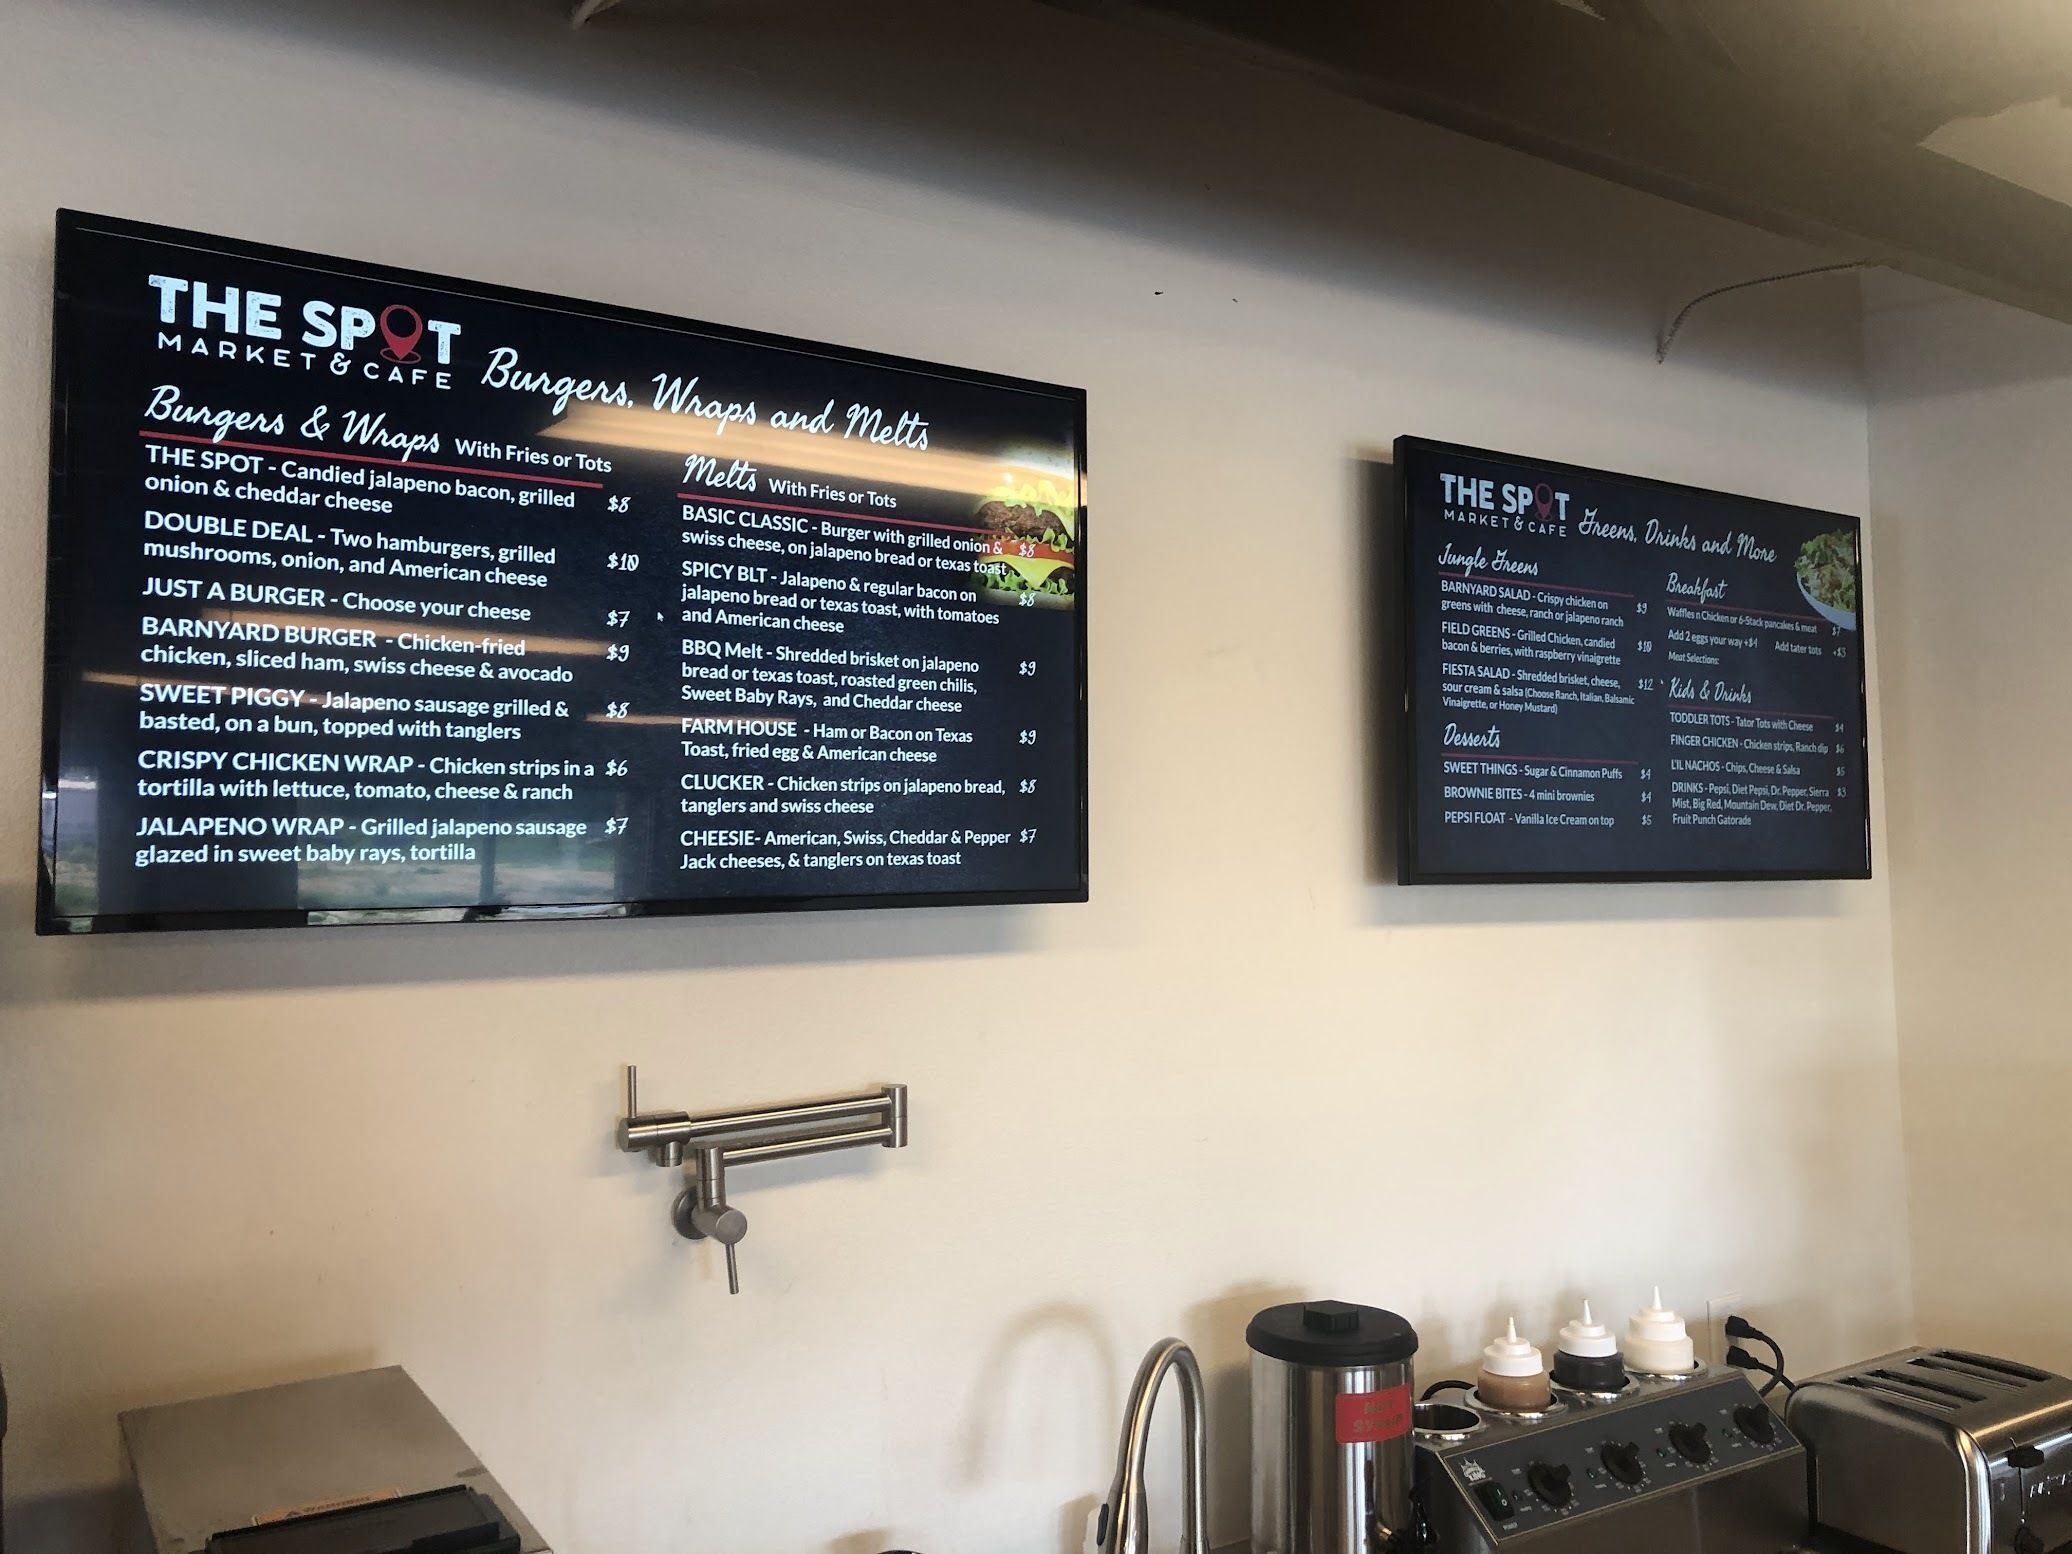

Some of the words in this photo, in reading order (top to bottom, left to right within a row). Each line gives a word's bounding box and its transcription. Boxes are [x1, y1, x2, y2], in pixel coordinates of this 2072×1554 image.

[148, 274, 283, 342] THE
[302, 300, 463, 365] SPOT
[158, 332, 316, 370] MARKET
[330, 352, 351, 375] &
[363, 362, 451, 390] CAFE
[480, 347, 635, 416] Burgers,
[652, 373, 756, 436] Wraps
[770, 399, 834, 433] and
[844, 403, 929, 450] Melts
[144, 385, 286, 443] Burgers
[300, 405, 330, 441] &
[342, 410, 440, 462] Wraps
[455, 438, 501, 459] With
[506, 445, 549, 465] Fries
[553, 455, 572, 467] or
[575, 453, 612, 473] Tots
[683, 454, 757, 492] Melts
[145, 474, 208, 495] onion
[213, 479, 231, 497] &
[235, 482, 321, 506] cheddar
[325, 491, 393, 513] cheese
[607, 495, 631, 513] $8
[768, 478, 807, 497] With
[810, 483, 846, 502] Fries
[849, 492, 864, 504] or
[866, 491, 897, 508] Tots
[1440, 473, 1495, 511] THE
[1502, 483, 1571, 522] SPOT
[1444, 509, 1509, 528] MARKET
[1514, 516, 1524, 531] &
[1528, 521, 1566, 537] CAFE
[1645, 518, 1696, 551] Drinks
[1702, 531, 1732, 555] and
[1736, 533, 1777, 563] More
[144, 542, 277, 568] mushrooms,
[281, 552, 344, 573] onion,
[349, 557, 384, 574] and
[389, 559, 481, 582] American
[485, 567, 547, 587] cheese
[607, 552, 639, 571] $10
[682, 530, 724, 546] swiss
[728, 533, 785, 555] cheese,
[788, 543, 807, 555] on
[809, 541, 872, 562] jalapeno
[875, 548, 914, 566] bread
[918, 557, 933, 568] or
[935, 556, 971, 572] texas
[974, 560, 1007, 577] toast
[1438, 543, 1488, 576] Jungle
[1491, 549, 1538, 576] Greens
[1666, 572, 1728, 603] Breakfast
[606, 610, 630, 628] $7
[1441, 600, 1472, 611] greens
[1473, 601, 1493, 613] with
[1530, 608, 1553, 620] ranch
[1555, 612, 1565, 621] or
[1565, 610, 1600, 625] jalapeno
[1601, 616, 1624, 627] ranch
[1636, 602, 1647, 614] $9
[606, 644, 629, 662] $9
[1442, 638, 1469, 652] bacon
[1470, 641, 1478, 653] &
[1514, 645, 1534, 657] with
[1535, 648, 1576, 663] raspberry
[1576, 651, 1621, 666] vinaigrette
[1637, 640, 1652, 653] $10
[1668, 651, 1686, 662] Meat
[141, 644, 231, 668] chicken,
[236, 649, 296, 669] sliced
[301, 652, 349, 674] ham,
[354, 656, 406, 674] swiss
[410, 658, 476, 678] cheese
[479, 662, 494, 678] &
[498, 666, 573, 682] avocado
[1442, 683, 1463, 692] sour
[1464, 684, 1492, 695] cream
[1493, 684, 1501, 695] &
[1502, 685, 1524, 697] salsa
[1604, 693, 1635, 705] Balsamic
[1638, 678, 1654, 691] $12
[1669, 677, 1695, 699] Kids
[1699, 680, 1710, 700] &
[1714, 681, 1751, 704] Drinks
[681, 685, 732, 702] Sweet
[735, 687, 774, 707] Baby
[778, 690, 817, 708] Rays,
[823, 693, 850, 707] and
[853, 693, 913, 710] Cheddar
[915, 697, 962, 712] cheese
[1489, 702, 1499, 710] or
[1499, 702, 1524, 714] Honey
[1524, 702, 1558, 715] Mustard)
[1669, 711, 1709, 725] TODDLER
[1709, 714, 1730, 726] TOTS
[1735, 716, 1755, 727] Tator
[1755, 717, 1771, 729] Tots
[1771, 719, 1788, 729] with
[1788, 720, 1813, 732] Cheese
[1444, 723, 1500, 748] Desserts
[605, 759, 628, 776] $6
[1444, 761, 1479, 774] SWEET
[1480, 762, 1518, 775] THINGS
[1524, 765, 1549, 778] Sugar
[1550, 766, 1557, 777] &
[1558, 766, 1601, 778] Cinnamon
[1601, 768, 1623, 779] Puffs
[1640, 768, 1651, 780] $4
[137, 778, 215, 796] tortilla
[219, 779, 267, 797] with
[273, 779, 350, 800] lettuce,
[354, 782, 431, 801] tomato,
[435, 782, 500, 799] cheese
[503, 783, 518, 799] &
[523, 784, 573, 800] ranch
[1019, 779, 1037, 794] $8
[1444, 786, 1494, 799] BROWNIE
[1495, 787, 1523, 800] BITES
[1529, 789, 1535, 800] 4
[1537, 789, 1555, 800] mini
[1556, 789, 1595, 802] brownies
[1641, 791, 1652, 803] $4
[605, 817, 629, 835] $7
[1642, 814, 1652, 826] $5
[1672, 813, 1692, 825] Fruit
[1692, 814, 1716, 825] Punch
[1717, 814, 1752, 825] Gatorade
[764, 830, 841, 847] American,
[843, 830, 887, 847] Swiss,
[889, 830, 948, 844] Cheddar
[951, 830, 962, 844] &
[965, 830, 1011, 846] Pepper
[1020, 829, 1037, 843] $7
[680, 854, 716, 869] Jack
[719, 853, 785, 870] cheeses,
[788, 852, 800, 867] &
[803, 852, 863, 870] tanglers
[866, 855, 884, 866] on
[886, 853, 924, 866] texas
[926, 852, 961, 865] toast
